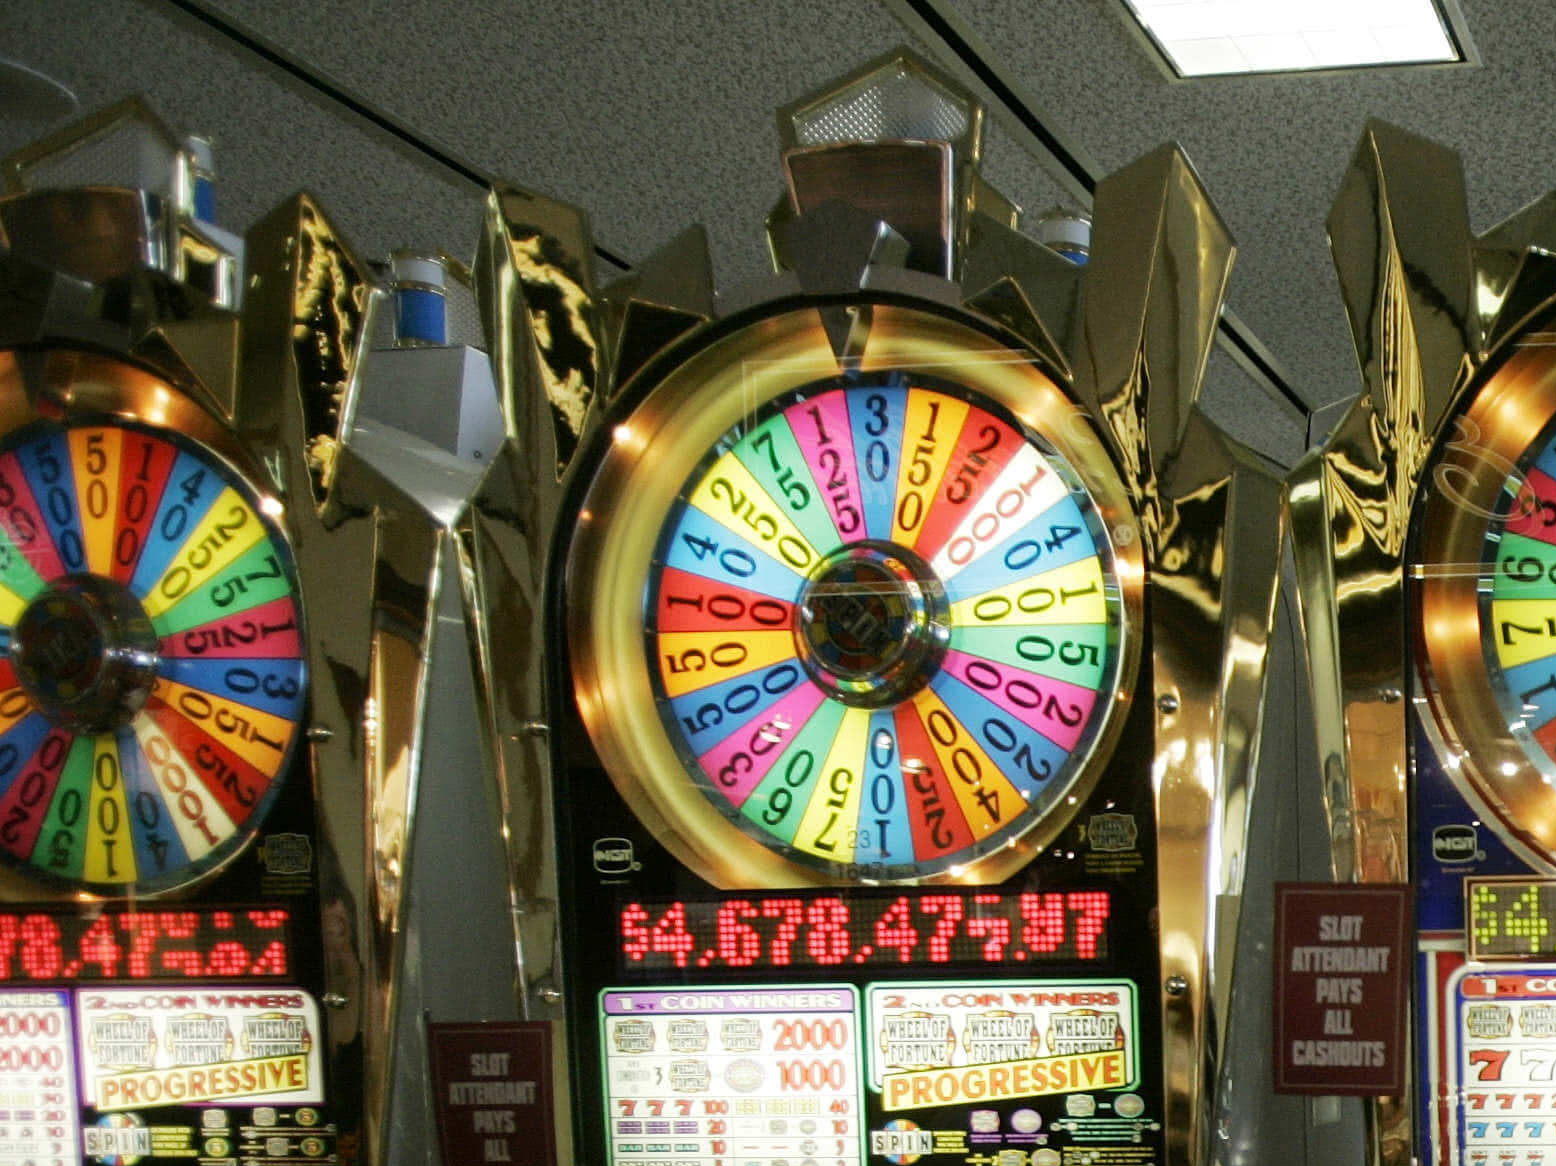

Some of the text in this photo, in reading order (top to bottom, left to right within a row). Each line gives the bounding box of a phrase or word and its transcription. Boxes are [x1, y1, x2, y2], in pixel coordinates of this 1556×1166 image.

[865, 392, 890, 483] 30
[752, 431, 811, 510] 75
[805, 406, 861, 534] 125
[897, 402, 940, 531] 150
[946, 425, 1001, 505] 25
[710, 477, 813, 570] 250
[947, 467, 1045, 566] 1000
[681, 527, 757, 578] 40
[665, 592, 789, 624] 100
[973, 580, 1099, 622] 100
[666, 639, 748, 673] 50
[685, 664, 799, 735] 500
[965, 661, 1082, 728] 200
[1319, 915, 1363, 942] SLOT
[1292, 946, 1390, 972] ATTENDANT
[660, 992, 842, 1010] COIN WINNERS
[942, 992, 1120, 1008] COIN WINNERS
[1316, 978, 1363, 1004] PAYS
[772, 1018, 848, 1051] 2000
[929, 1019, 946, 1037] OF
[1323, 1009, 1353, 1036] ALL
[1292, 1040, 1385, 1067] CASHOUTS
[103, 1058, 303, 1101] PROGRESSIVE
[776, 1059, 846, 1091] 1000
[890, 1054, 1121, 1107] PROGRESSIVE
[87, 1131, 147, 1151] SPIN
[874, 1133, 931, 1152] SPIN
